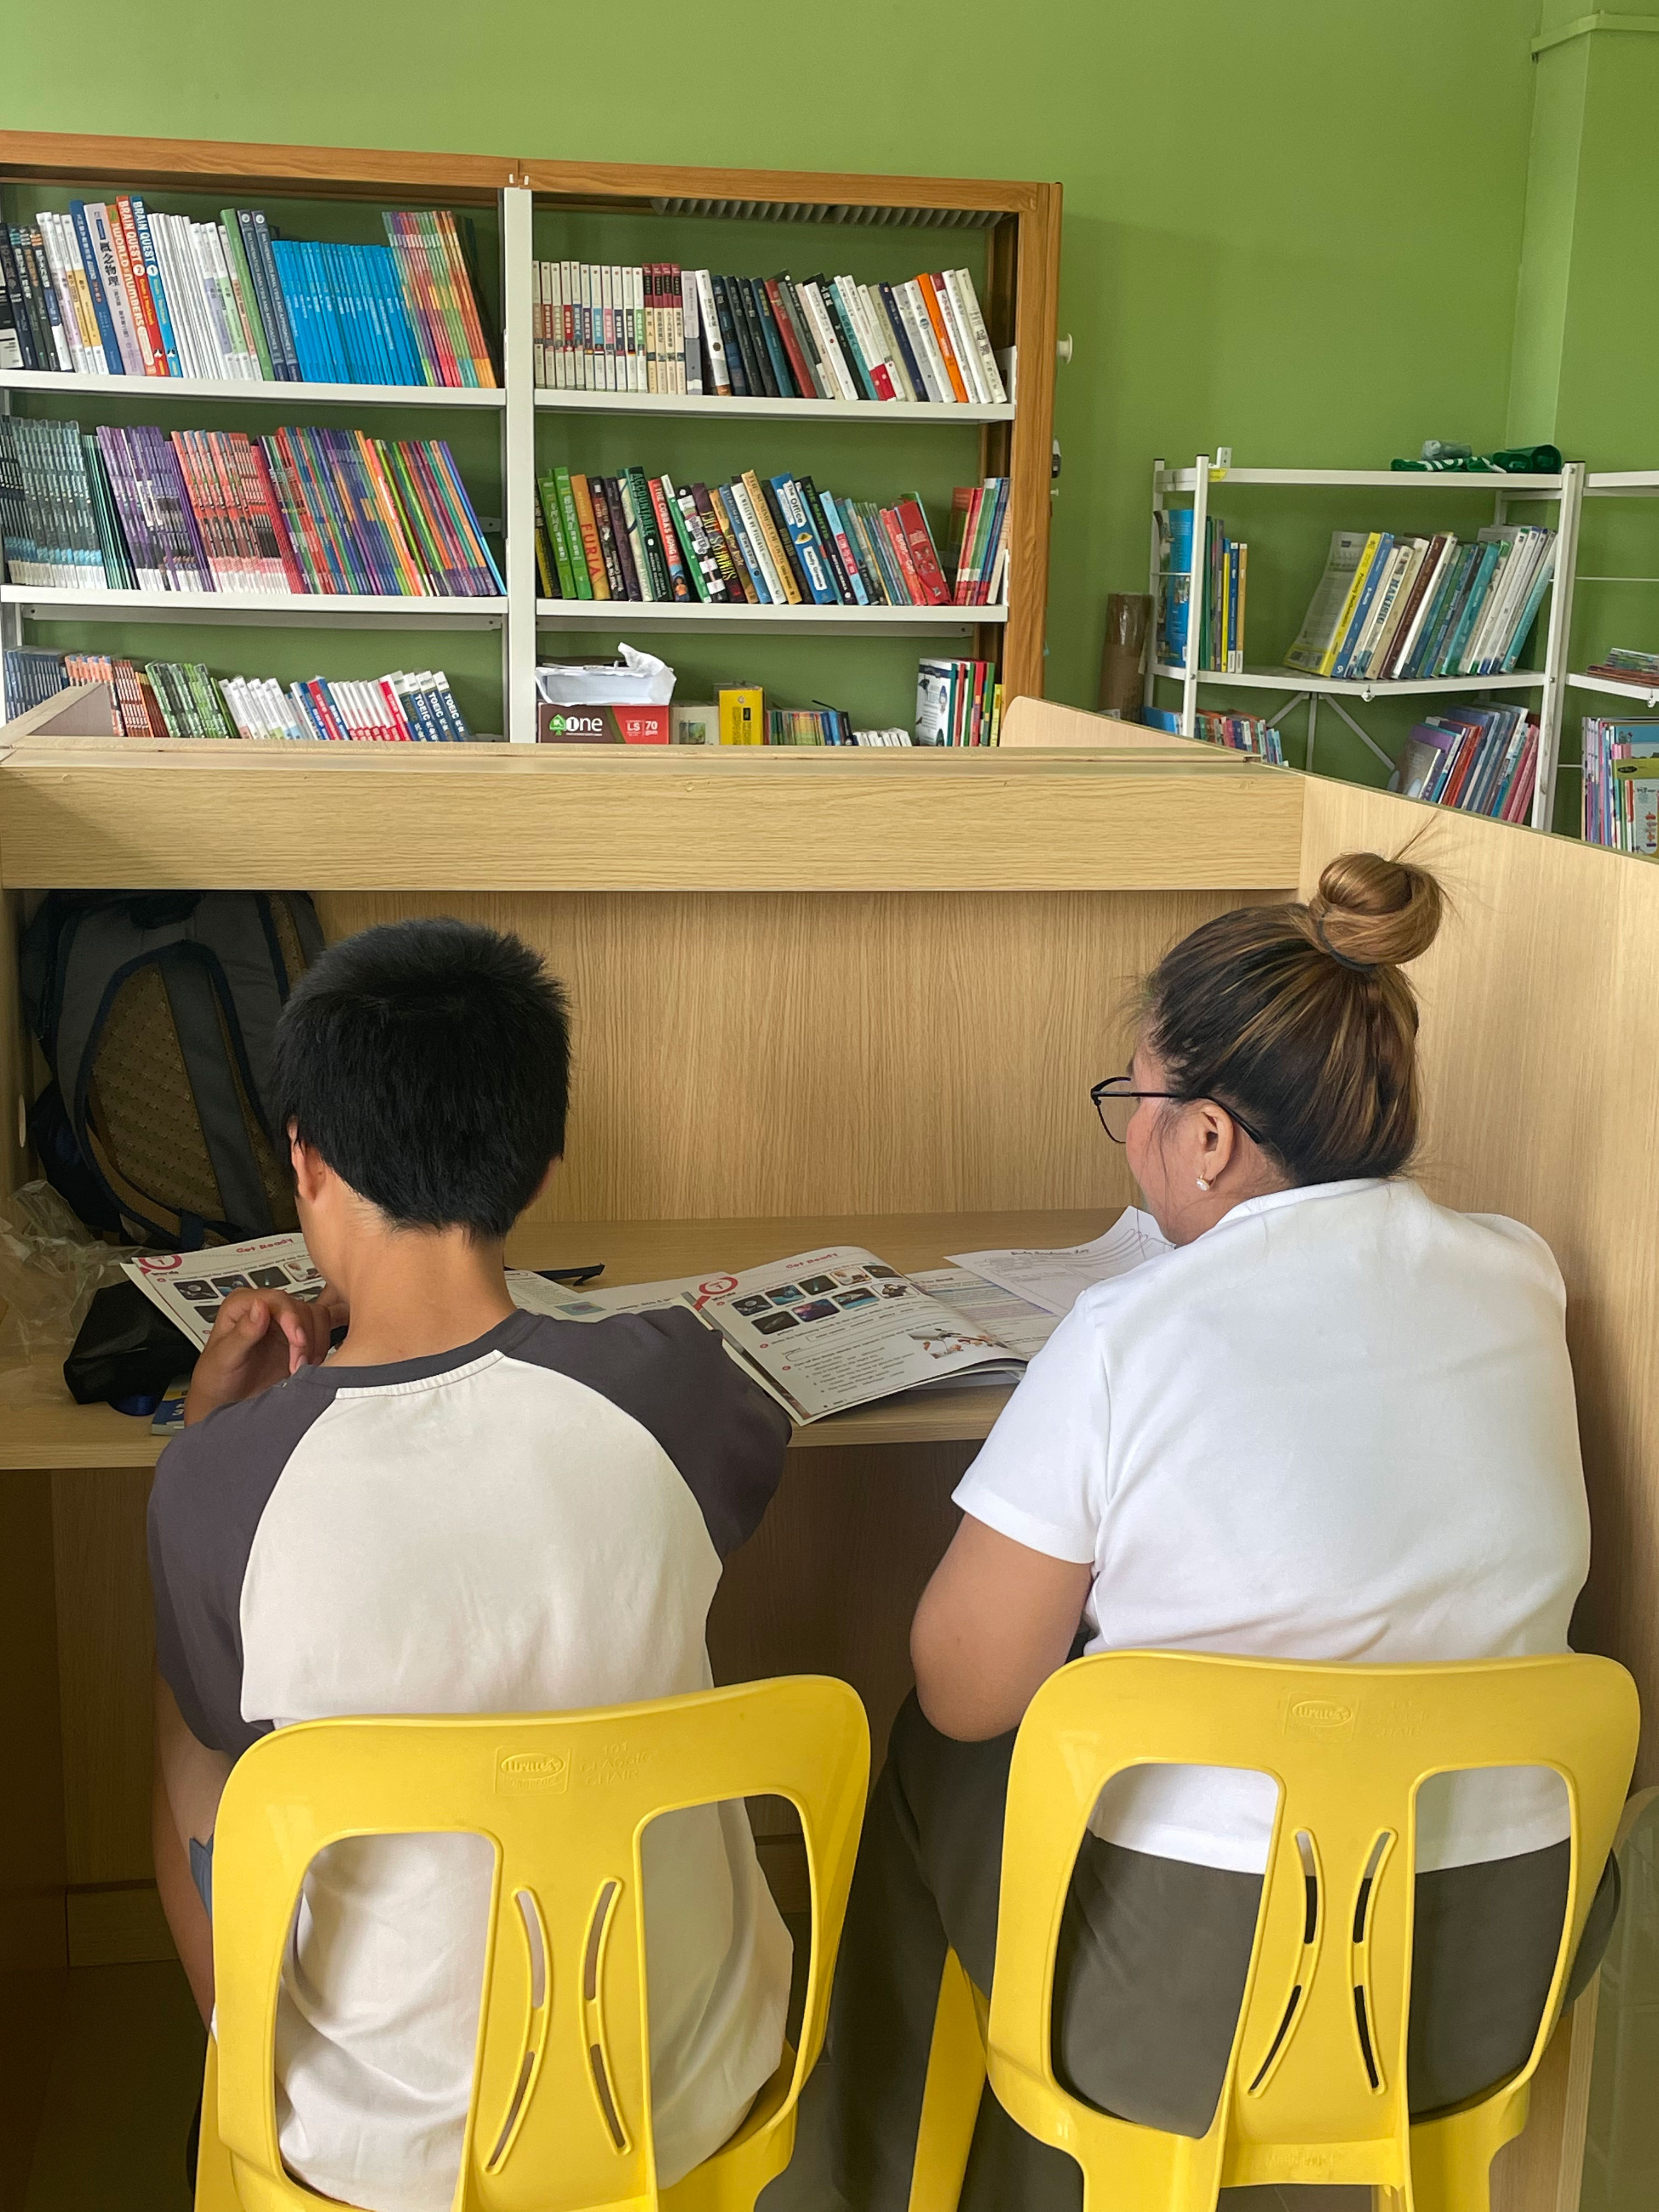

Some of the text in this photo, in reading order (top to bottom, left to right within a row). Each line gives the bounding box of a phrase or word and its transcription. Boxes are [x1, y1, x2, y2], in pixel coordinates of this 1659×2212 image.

[119, 200, 144, 275] BRAIN QUEST 2
[133, 200, 156, 275] BRAIN QUEST 1
[246, 232, 261, 272] MATHEMATICS
[259, 232, 275, 272] MATHEMATICS
[112, 227, 129, 267] WORLD
[124, 272, 145, 326] NUMBERS
[262, 300, 270, 312] AND
[276, 300, 284, 312] AND
[264, 312, 279, 349] APPROACHES
[279, 312, 293, 349] APPROACHES
[633, 472, 656, 535] ACCOUNTABLE
[654, 487, 664, 502] THE
[664, 534, 677, 555] SONG
[786, 484, 805, 524] The Office
[805, 483, 830, 540] THE MANTIS
[580, 522, 603, 577] FURIA
[804, 549, 825, 588] Andy Greene
[1340, 572, 1364, 628] Primary Mathematics
[1376, 578, 1400, 626] MAKISIG
[415, 693, 430, 721] TOEIC
[428, 692, 444, 718] TOEIC
[445, 693, 459, 719] TOEIC
[627, 722, 640, 731] LS
[645, 721, 658, 731] 70
[259, 1238, 294, 1249] Ready
[806, 1253, 838, 1263] Ready
[579, 1752, 653, 1773] CLASSIC
[602, 1741, 628, 1756] 101
[586, 1769, 641, 1787] CHAIR
